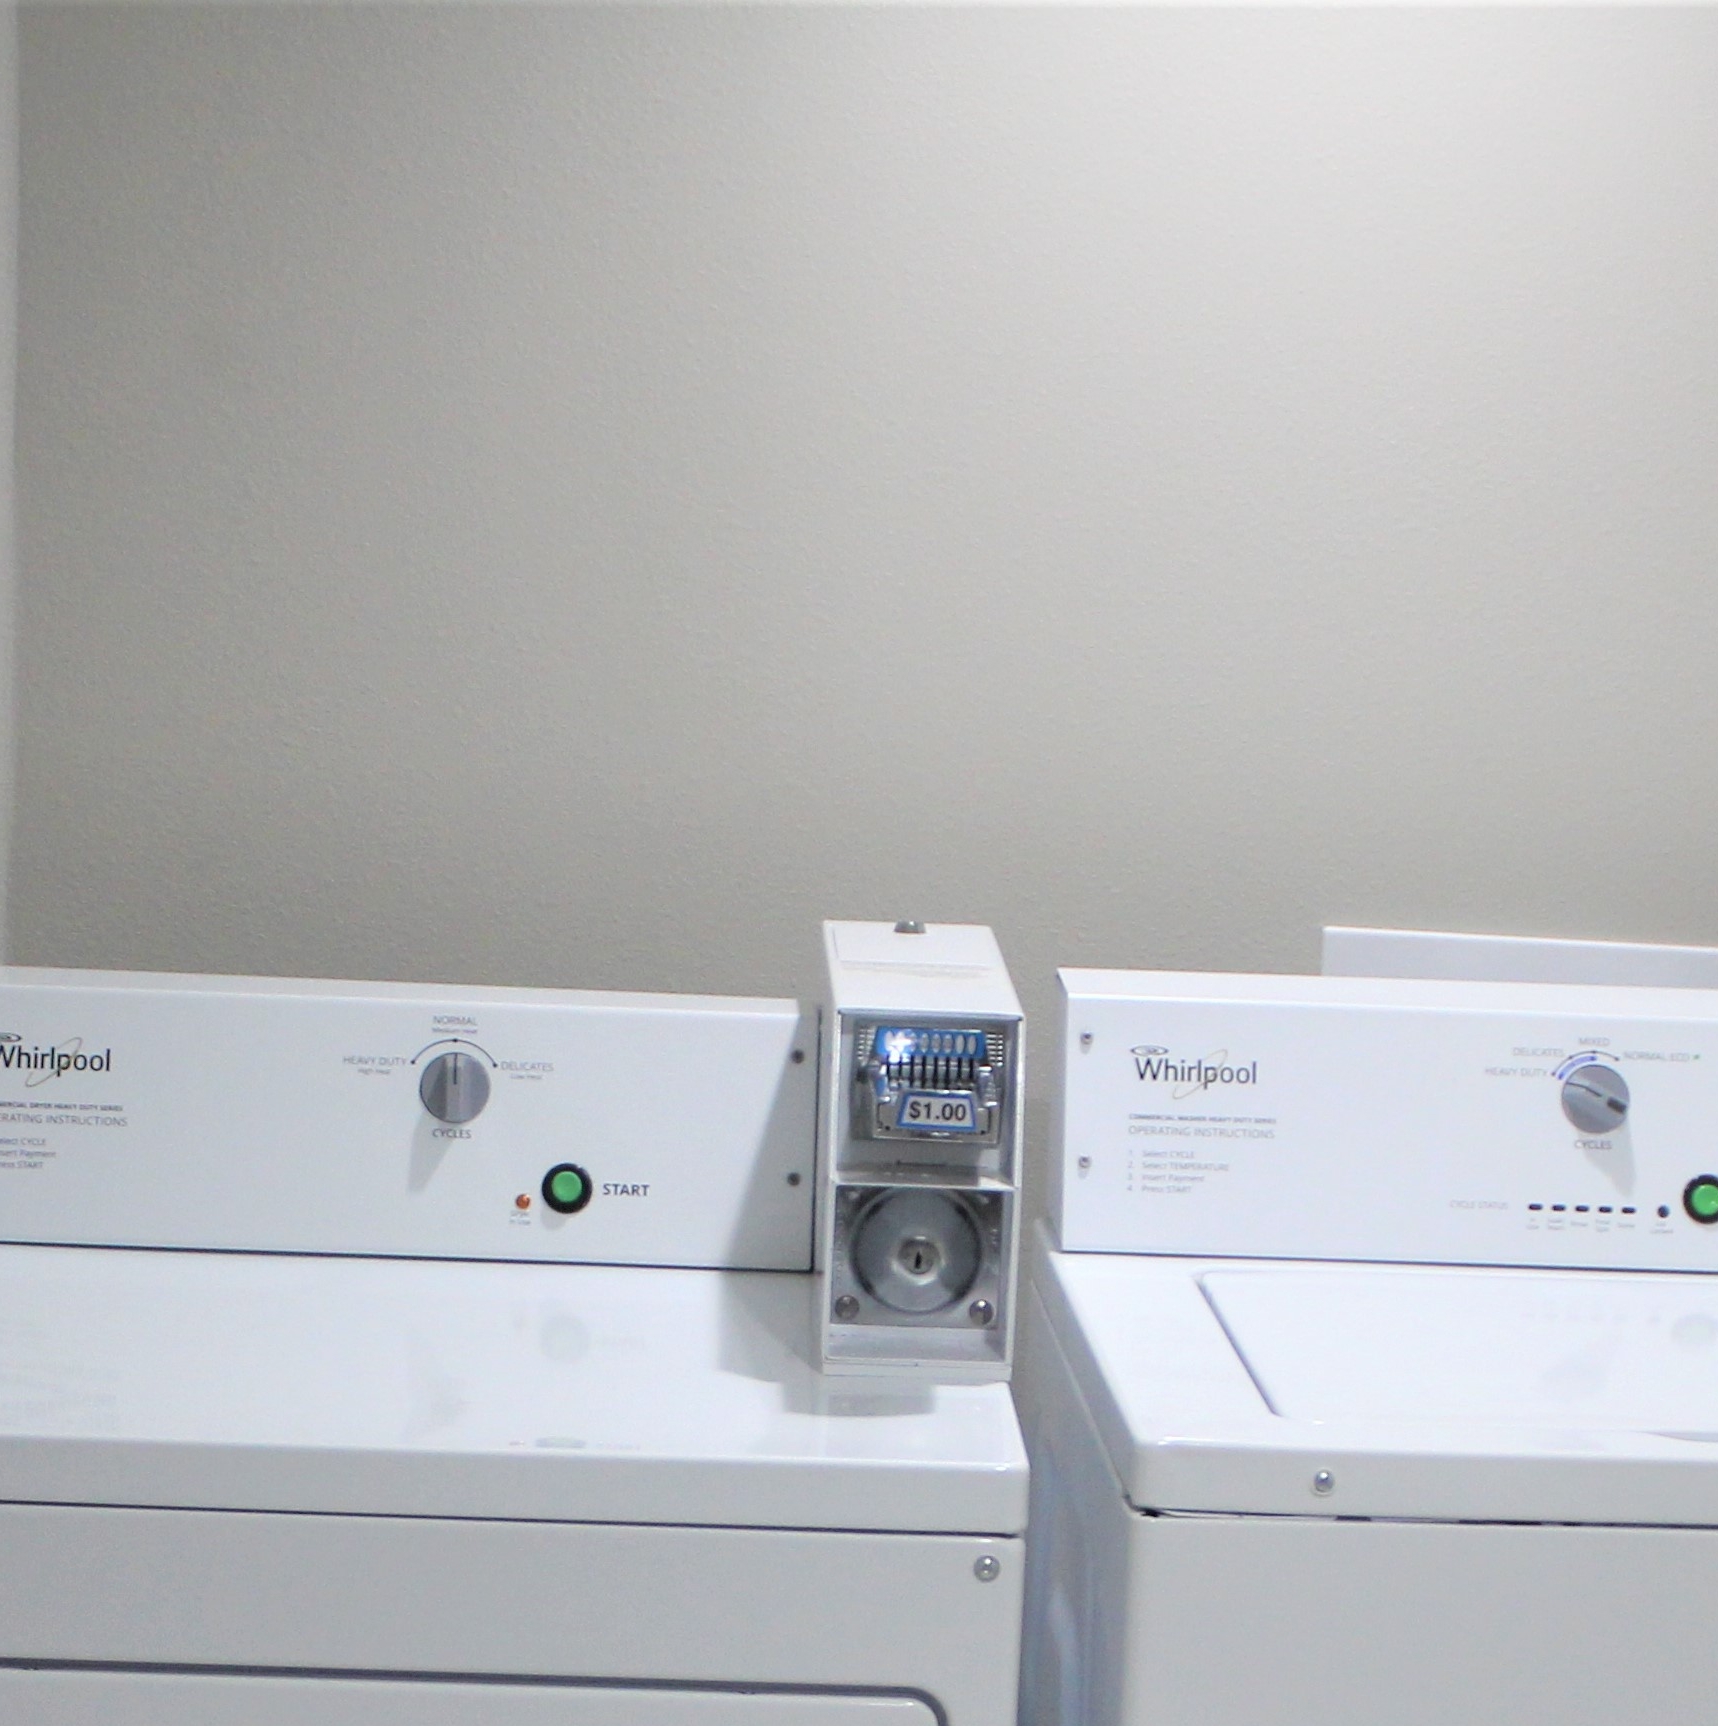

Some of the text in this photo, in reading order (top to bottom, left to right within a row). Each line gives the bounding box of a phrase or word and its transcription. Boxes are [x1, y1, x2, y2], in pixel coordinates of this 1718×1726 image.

[343, 1055, 376, 1065] HEAVY
[501, 1061, 555, 1072] DELICATES
[1135, 1057, 1257, 1090] Whirlpool
[909, 1101, 966, 1121] $1.00
[45, 1114, 128, 1127] INSTRUCTIONS
[432, 1129, 472, 1139] CYCLES
[1128, 1125, 1276, 1139] OPERATING INSTRUCTIONS
[1574, 1139, 1613, 1150] CYCLES
[602, 1183, 650, 1197] START
